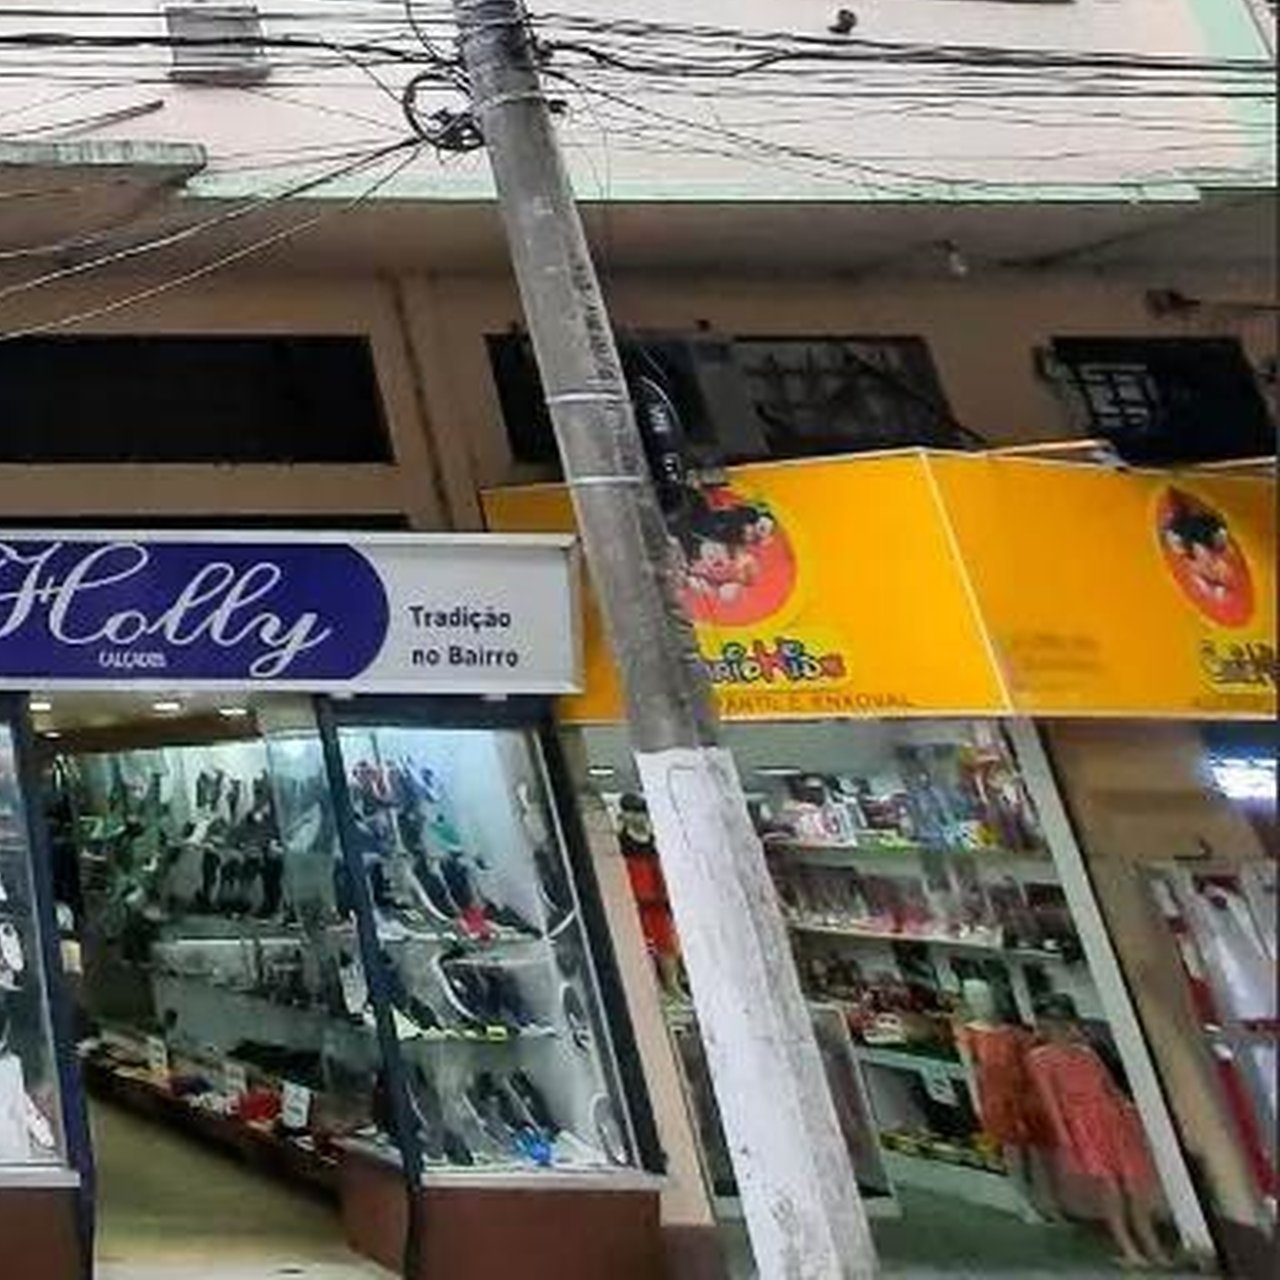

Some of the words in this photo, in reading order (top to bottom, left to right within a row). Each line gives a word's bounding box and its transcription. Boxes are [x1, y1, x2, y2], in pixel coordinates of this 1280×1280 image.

[408, 605, 512, 632] Tradição
[412, 649, 440, 666] no
[449, 645, 519, 667] Bairro
